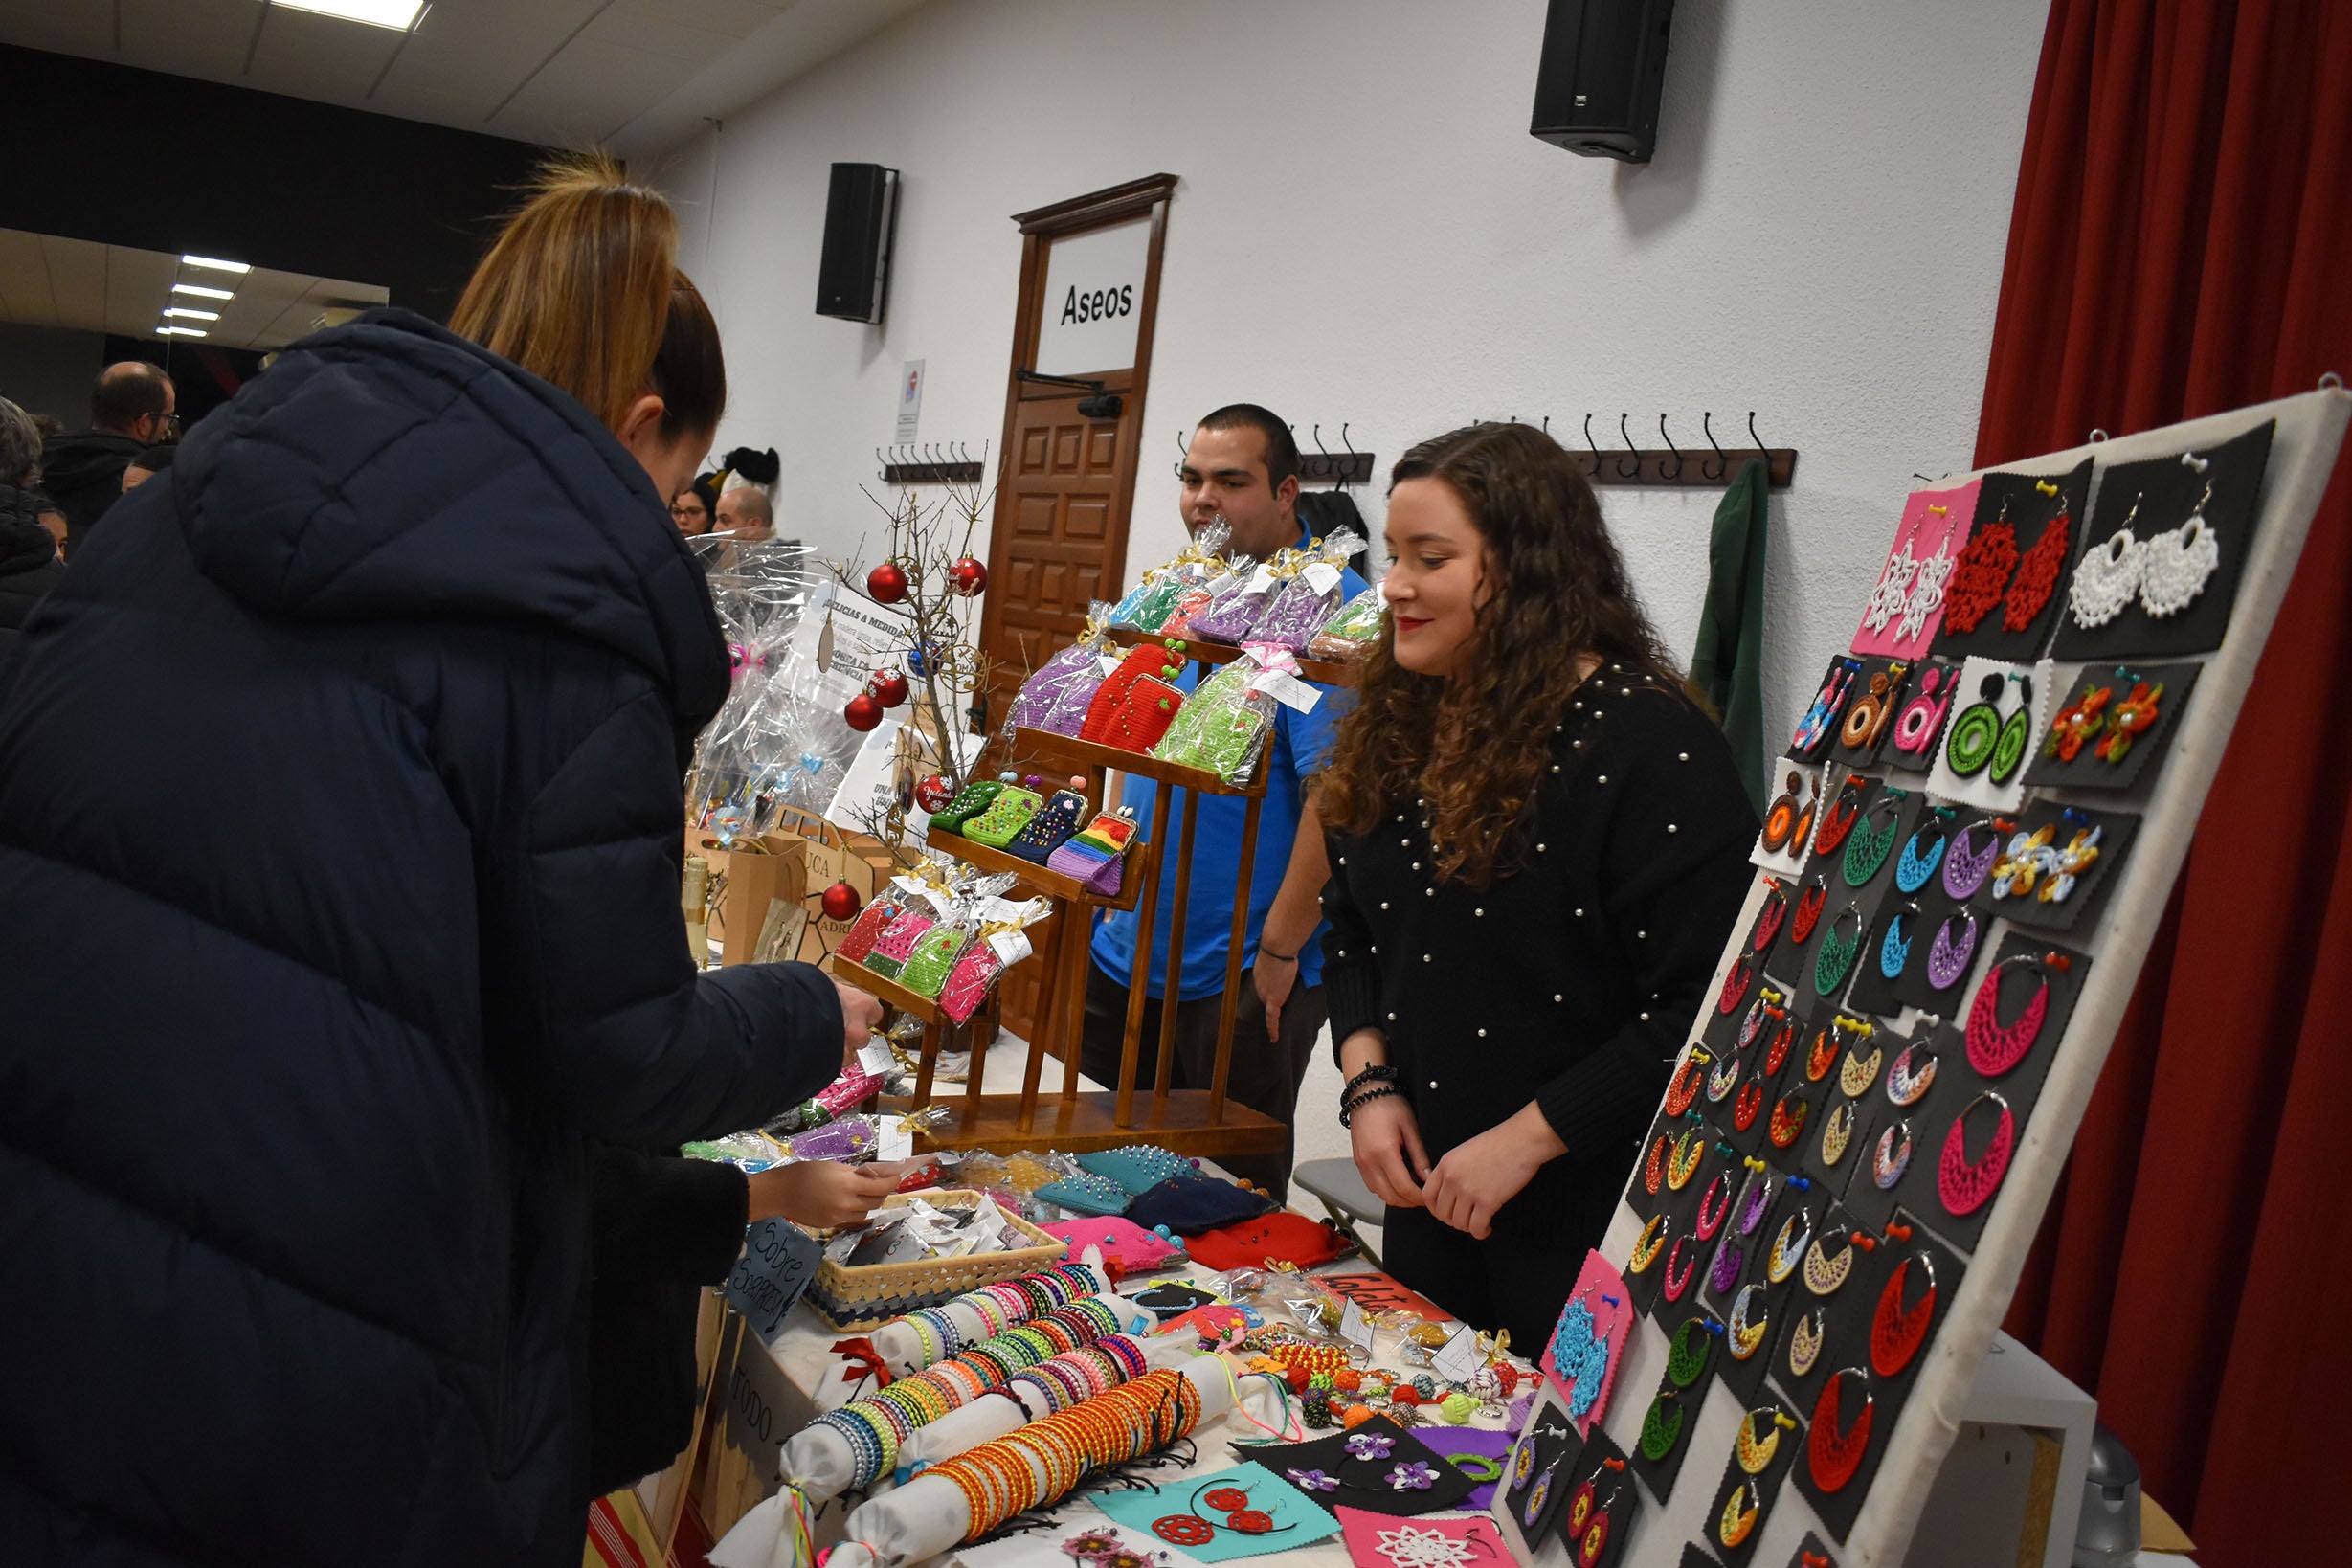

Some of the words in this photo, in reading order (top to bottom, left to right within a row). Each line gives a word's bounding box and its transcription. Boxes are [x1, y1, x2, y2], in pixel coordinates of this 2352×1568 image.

[1061, 284, 1132, 325] Aseos
[861, 614, 867, 623] A
[820, 921, 851, 934] ADRI
[755, 1222, 804, 1282] Sobre
[732, 1368, 772, 1442] TODO
